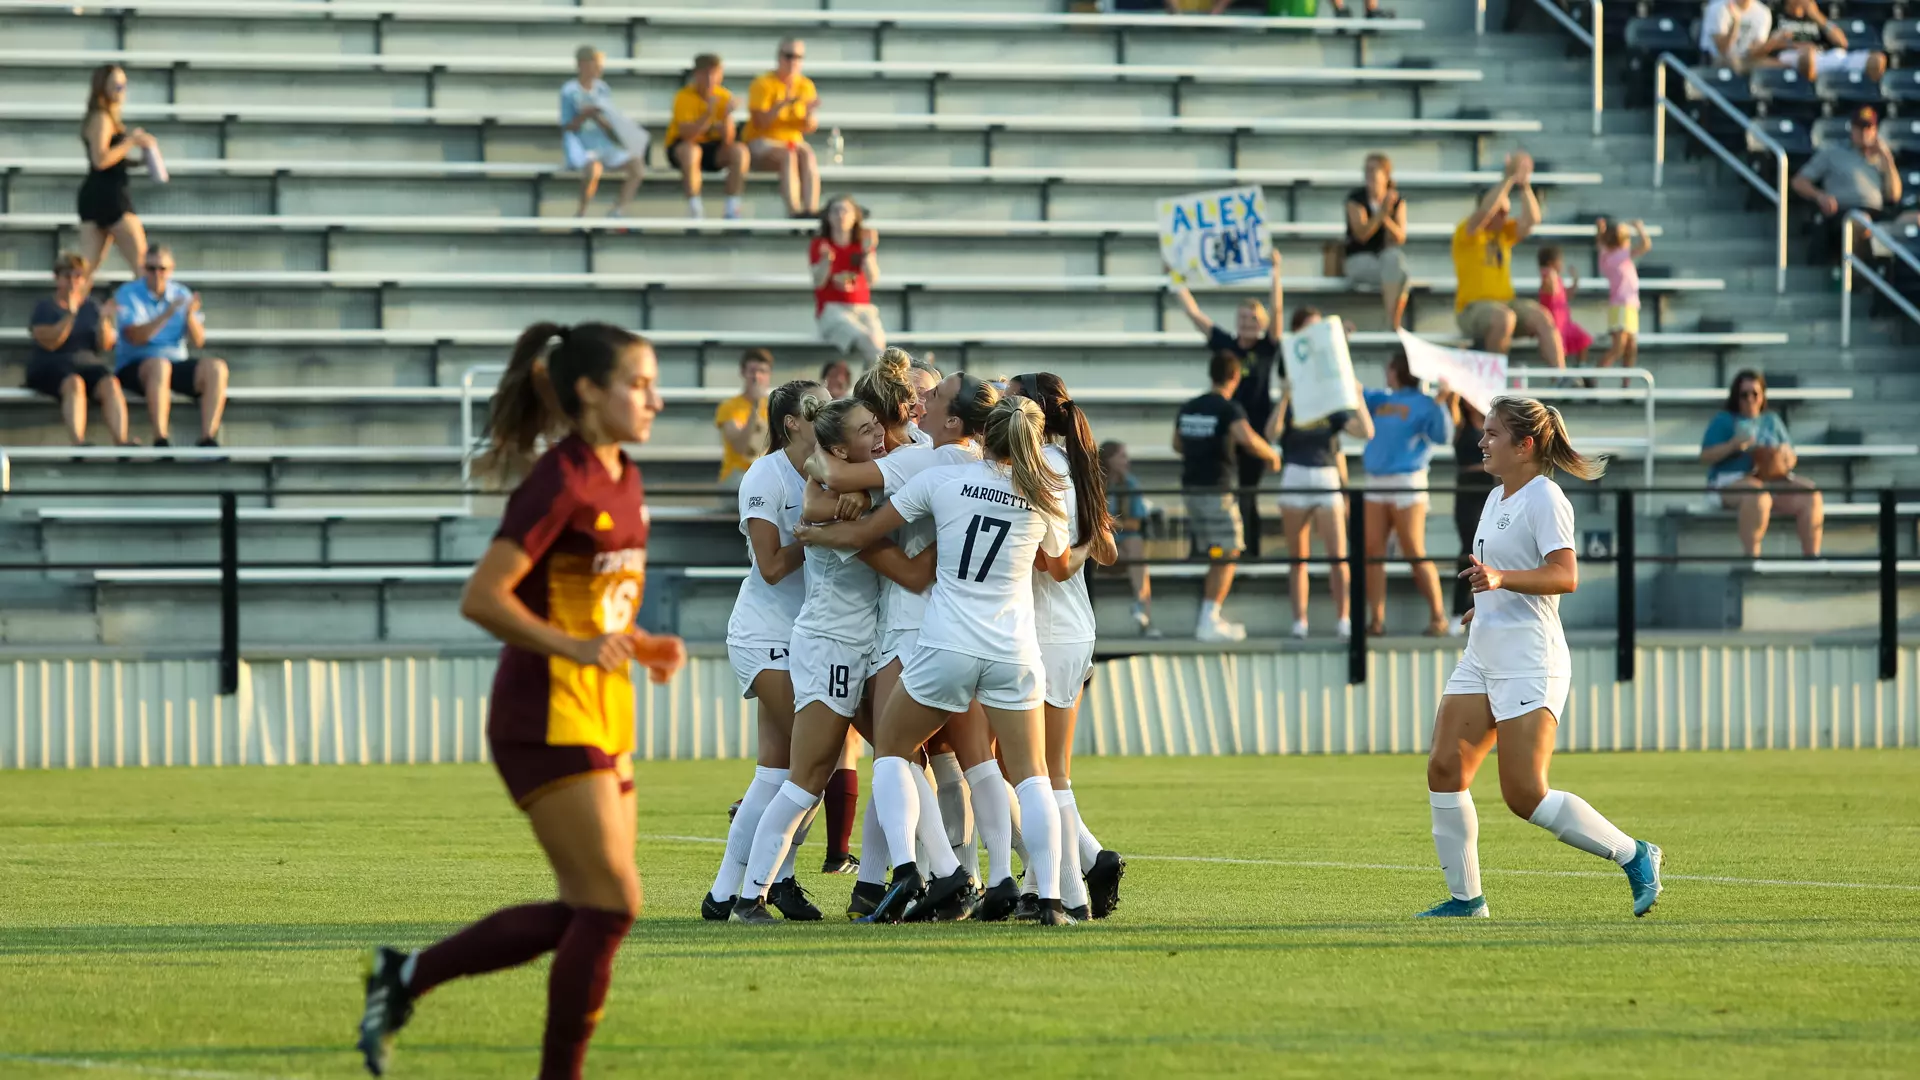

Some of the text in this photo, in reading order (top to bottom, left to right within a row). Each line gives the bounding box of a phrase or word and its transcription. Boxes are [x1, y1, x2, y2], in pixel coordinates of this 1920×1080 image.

[1173, 191, 1262, 233] ALEX
[957, 514, 1012, 583] 17
[829, 664, 849, 698] 19
